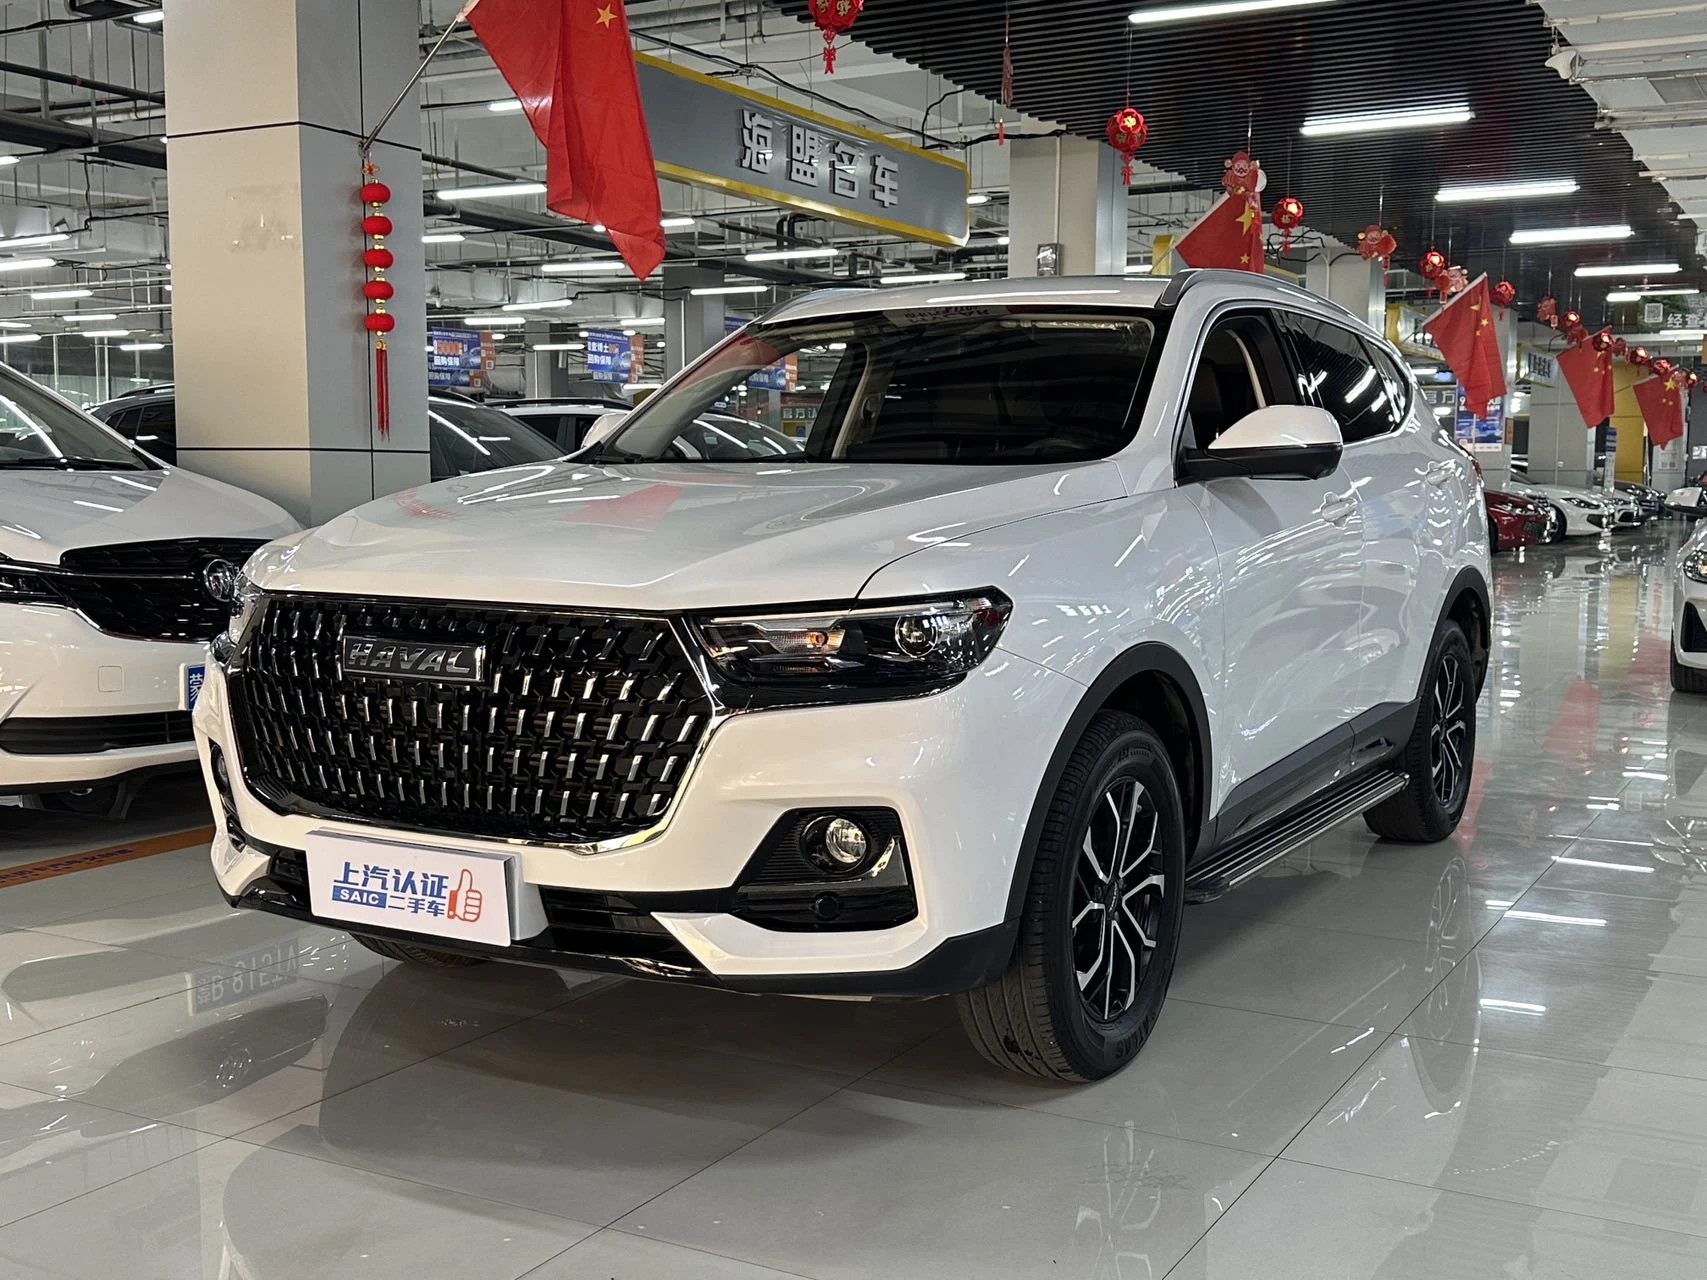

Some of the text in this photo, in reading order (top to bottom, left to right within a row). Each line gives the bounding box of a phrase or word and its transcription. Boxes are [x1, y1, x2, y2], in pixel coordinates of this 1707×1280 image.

[348, 643, 471, 674] HAVAL
[333, 861, 449, 900] 上汽认证
[339, 888, 447, 917] SAIC 二手车
